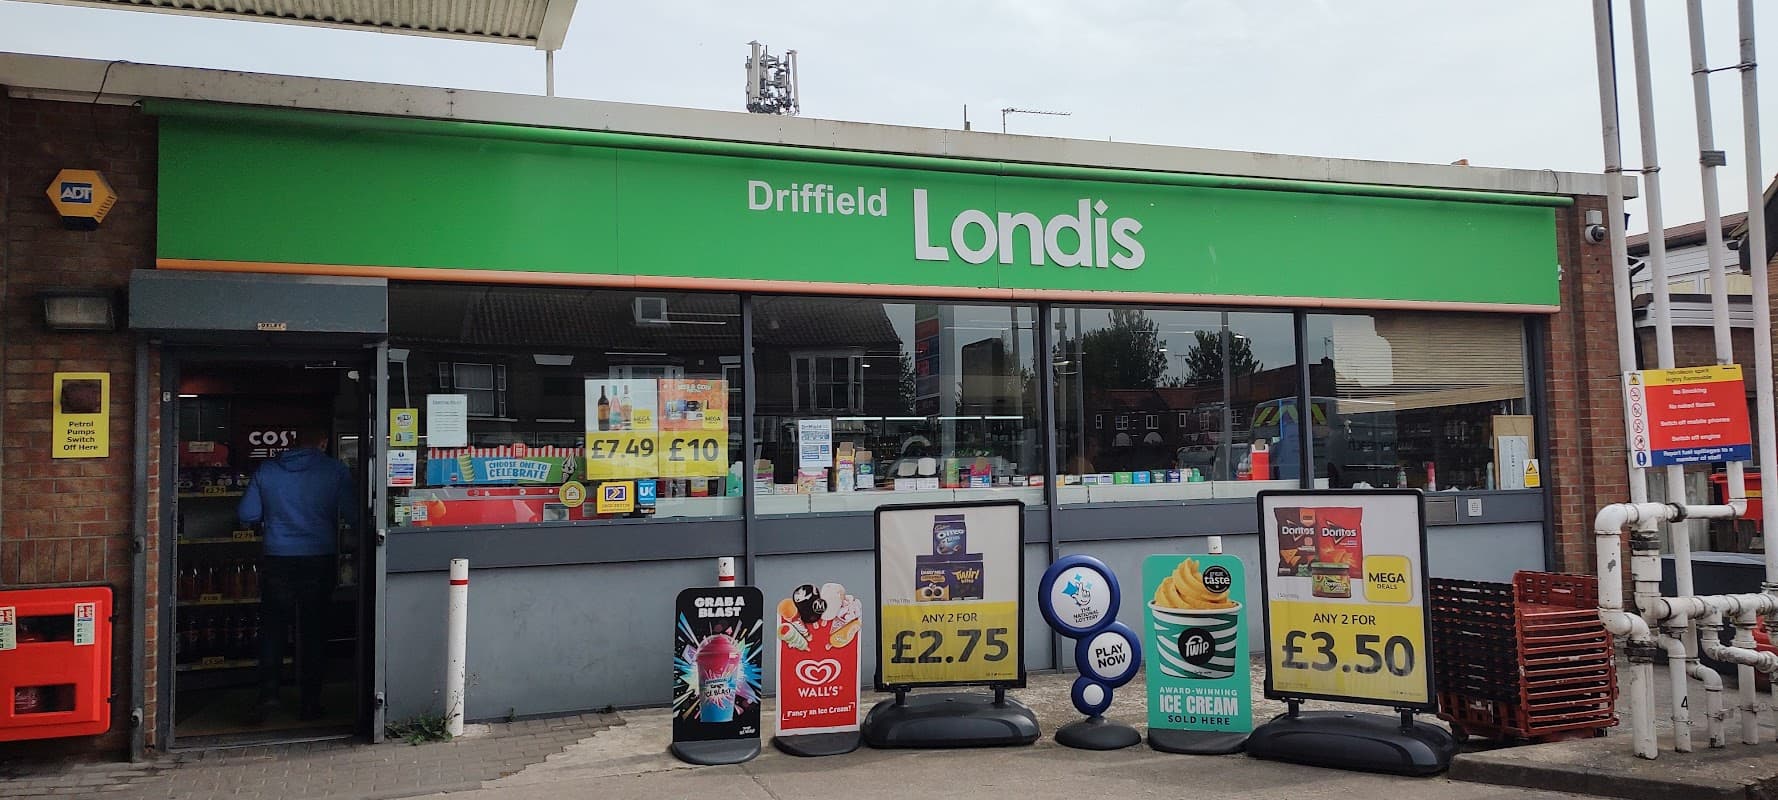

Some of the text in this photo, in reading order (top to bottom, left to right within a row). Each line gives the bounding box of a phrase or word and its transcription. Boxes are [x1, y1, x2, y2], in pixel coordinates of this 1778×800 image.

[60, 186, 93, 200] ADT
[747, 180, 888, 217] Driffield
[912, 188, 1146, 270] Londis
[68, 420, 94, 428] Petrol
[591, 438, 654, 459] £7.49
[668, 438, 719, 462] £10
[489, 461, 516, 469] CHOOSE
[520, 461, 535, 469] ONE
[489, 468, 547, 480] CELEBRATE
[1281, 526, 1315, 535] Doritos
[1321, 527, 1357, 537] Doritos
[1203, 576, 1231, 585] taste
[1368, 572, 1406, 583] MEGA
[694, 595, 746, 608] GRAB A
[698, 606, 742, 618] BLAST
[921, 612, 977, 623] ANY 2 FOR
[1073, 609, 1099, 618] NATIONAL
[1075, 614, 1098, 623] LOTTERY
[1312, 613, 1376, 626] ANY 2 FOR
[890, 627, 1010, 664] £2.75
[1095, 643, 1123, 658] PLAY
[1281, 630, 1416, 677] £3.50
[1097, 653, 1126, 669] NOW
[797, 685, 840, 698] WALL'S
[1159, 686, 1238, 696] AWARD-WINNING
[1159, 695, 1239, 716] ICE CREAM
[1680, 695, 1689, 711] 4
[818, 706, 828, 714] Ice
[1168, 715, 1231, 726] SOLD HERE
